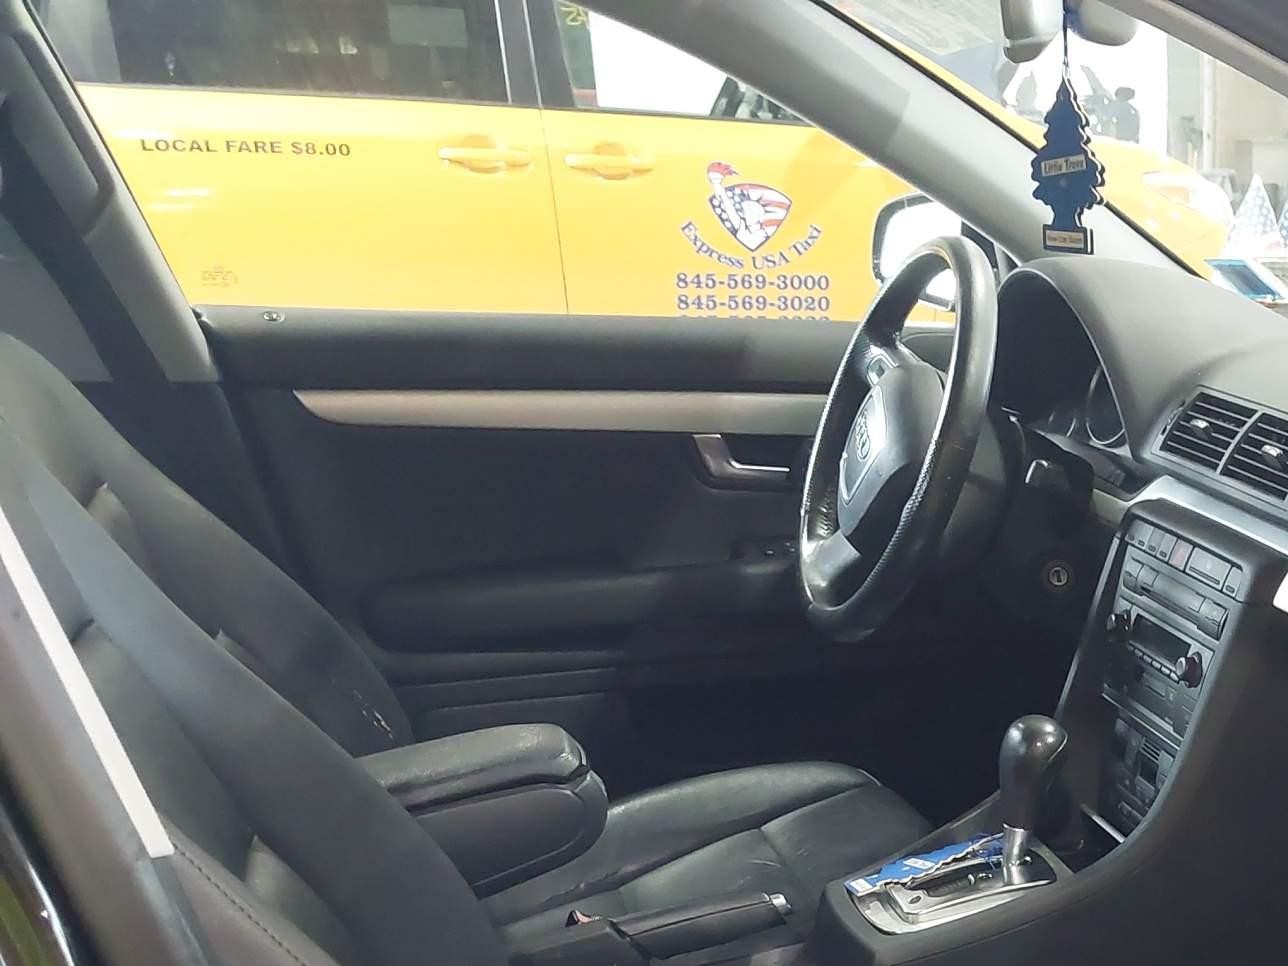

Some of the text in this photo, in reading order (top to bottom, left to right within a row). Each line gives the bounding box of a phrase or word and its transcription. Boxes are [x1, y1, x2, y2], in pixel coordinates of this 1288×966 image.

[140, 138, 351, 157] LOCAL FARE $8.00
[681, 221, 745, 269] Express
[752, 251, 790, 270] USA
[676, 272, 830, 290] 845-569-3000
[677, 294, 831, 312] 845-569-3020
